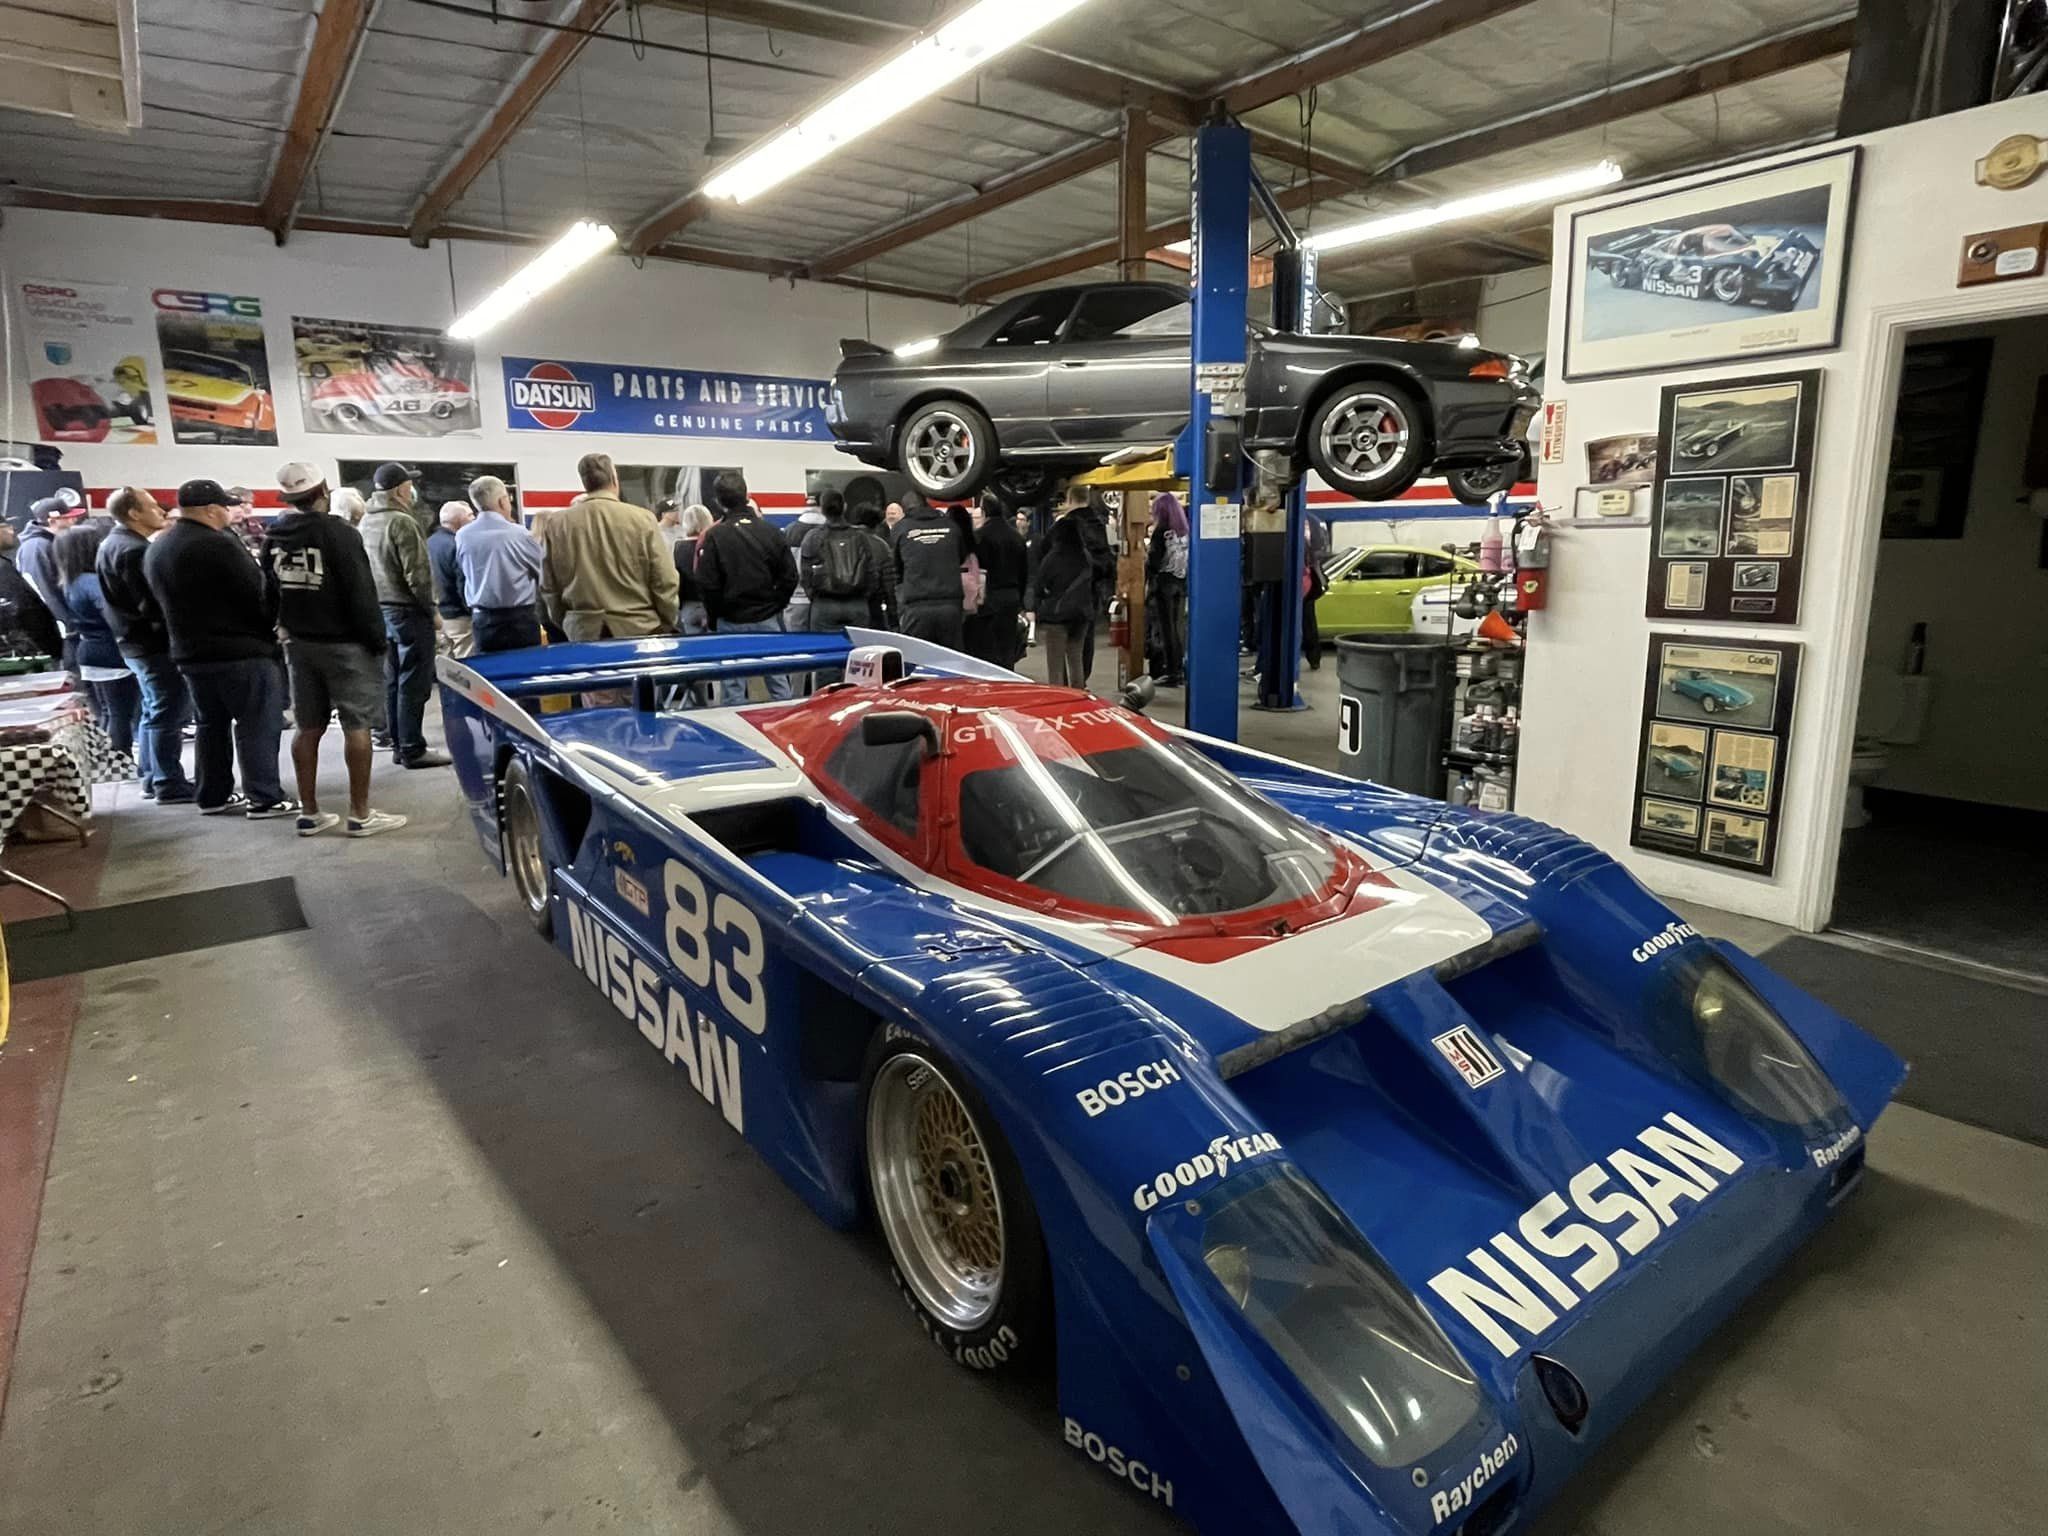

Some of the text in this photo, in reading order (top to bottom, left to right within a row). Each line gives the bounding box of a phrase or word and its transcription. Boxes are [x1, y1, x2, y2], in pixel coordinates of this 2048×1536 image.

[151, 288, 262, 318] CSRG
[1303, 251, 1315, 335] OTARY LIFT
[1642, 278, 1699, 299] NISSAN
[514, 382, 593, 409] DATSUN
[613, 372, 829, 410] PARTS AND SERVIC
[654, 413, 814, 434] GENUINE PARTS
[1747, 654, 1775, 666] Code
[1033, 705, 1135, 733] ZX-TURB
[664, 857, 767, 1036] 83
[567, 896, 744, 1136] NISSAN
[1076, 1058, 1181, 1118] BOSCH
[1133, 1132, 1283, 1212] GOODYEAR
[1427, 1111, 1744, 1358] NISSAN
[1064, 1416, 1174, 1508] BOSCH
[1430, 1432, 1519, 1525] Raychem
